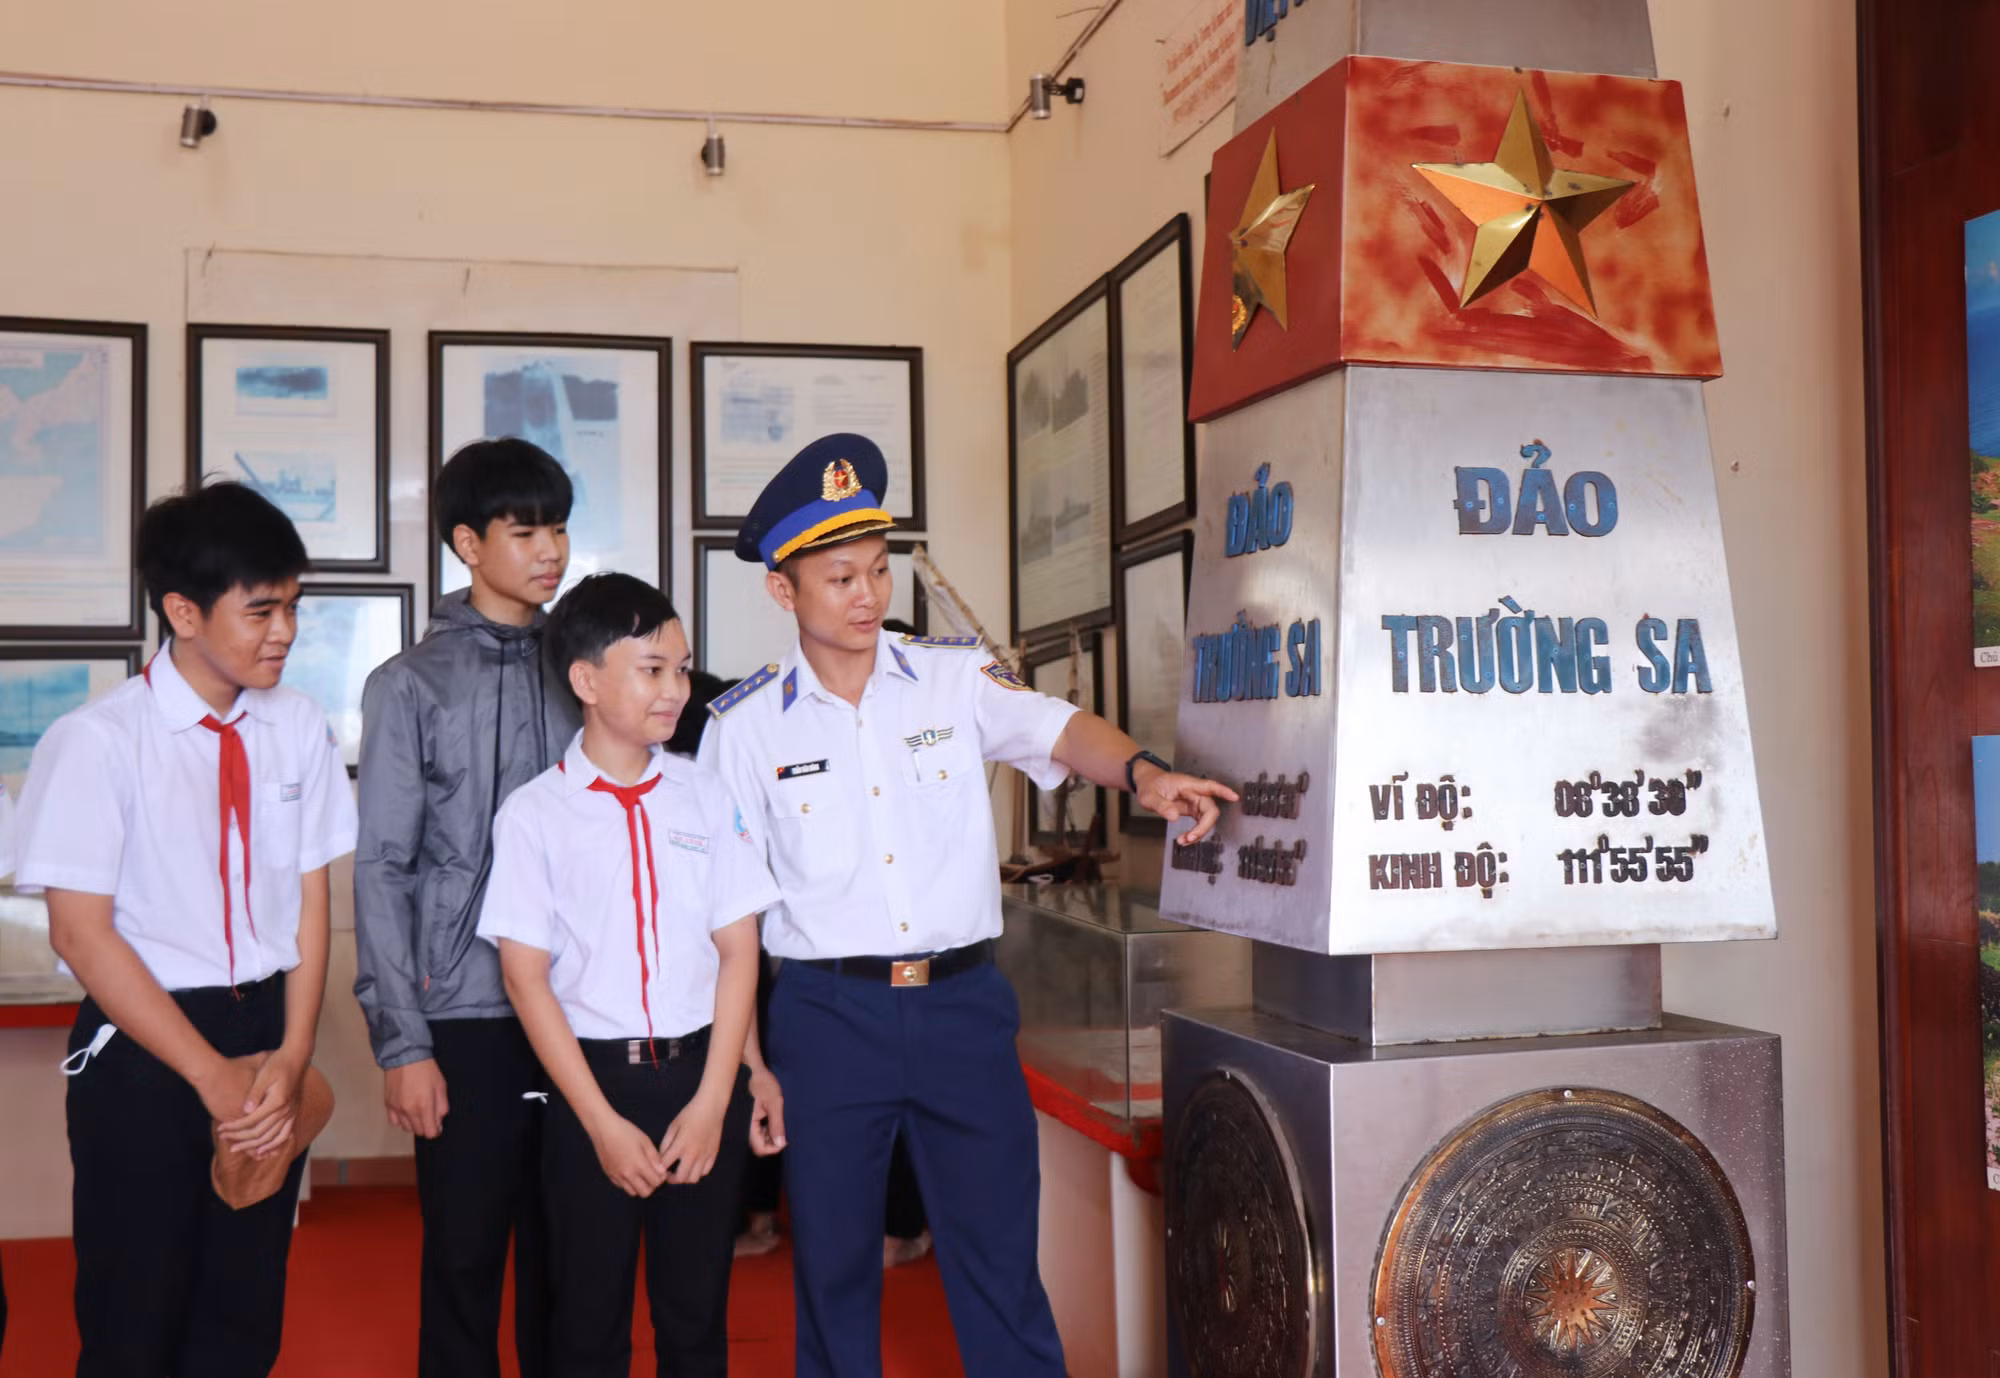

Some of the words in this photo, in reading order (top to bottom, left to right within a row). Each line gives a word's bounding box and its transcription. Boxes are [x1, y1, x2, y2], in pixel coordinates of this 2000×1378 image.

[1225, 462, 1294, 557] ĐẢO
[1454, 439, 1618, 537] ĐẢO
[1192, 609, 1281, 703] TRƯỜNG
[1285, 617, 1321, 698] SA
[1382, 595, 1612, 694] TRƯỜNG
[1635, 613, 1713, 694] SA
[1369, 770, 1408, 821] VĨ
[1415, 774, 1473, 831] ĐỘ:
[1368, 851, 1443, 890] KINH
[1454, 841, 1510, 899] ĐỘ:
